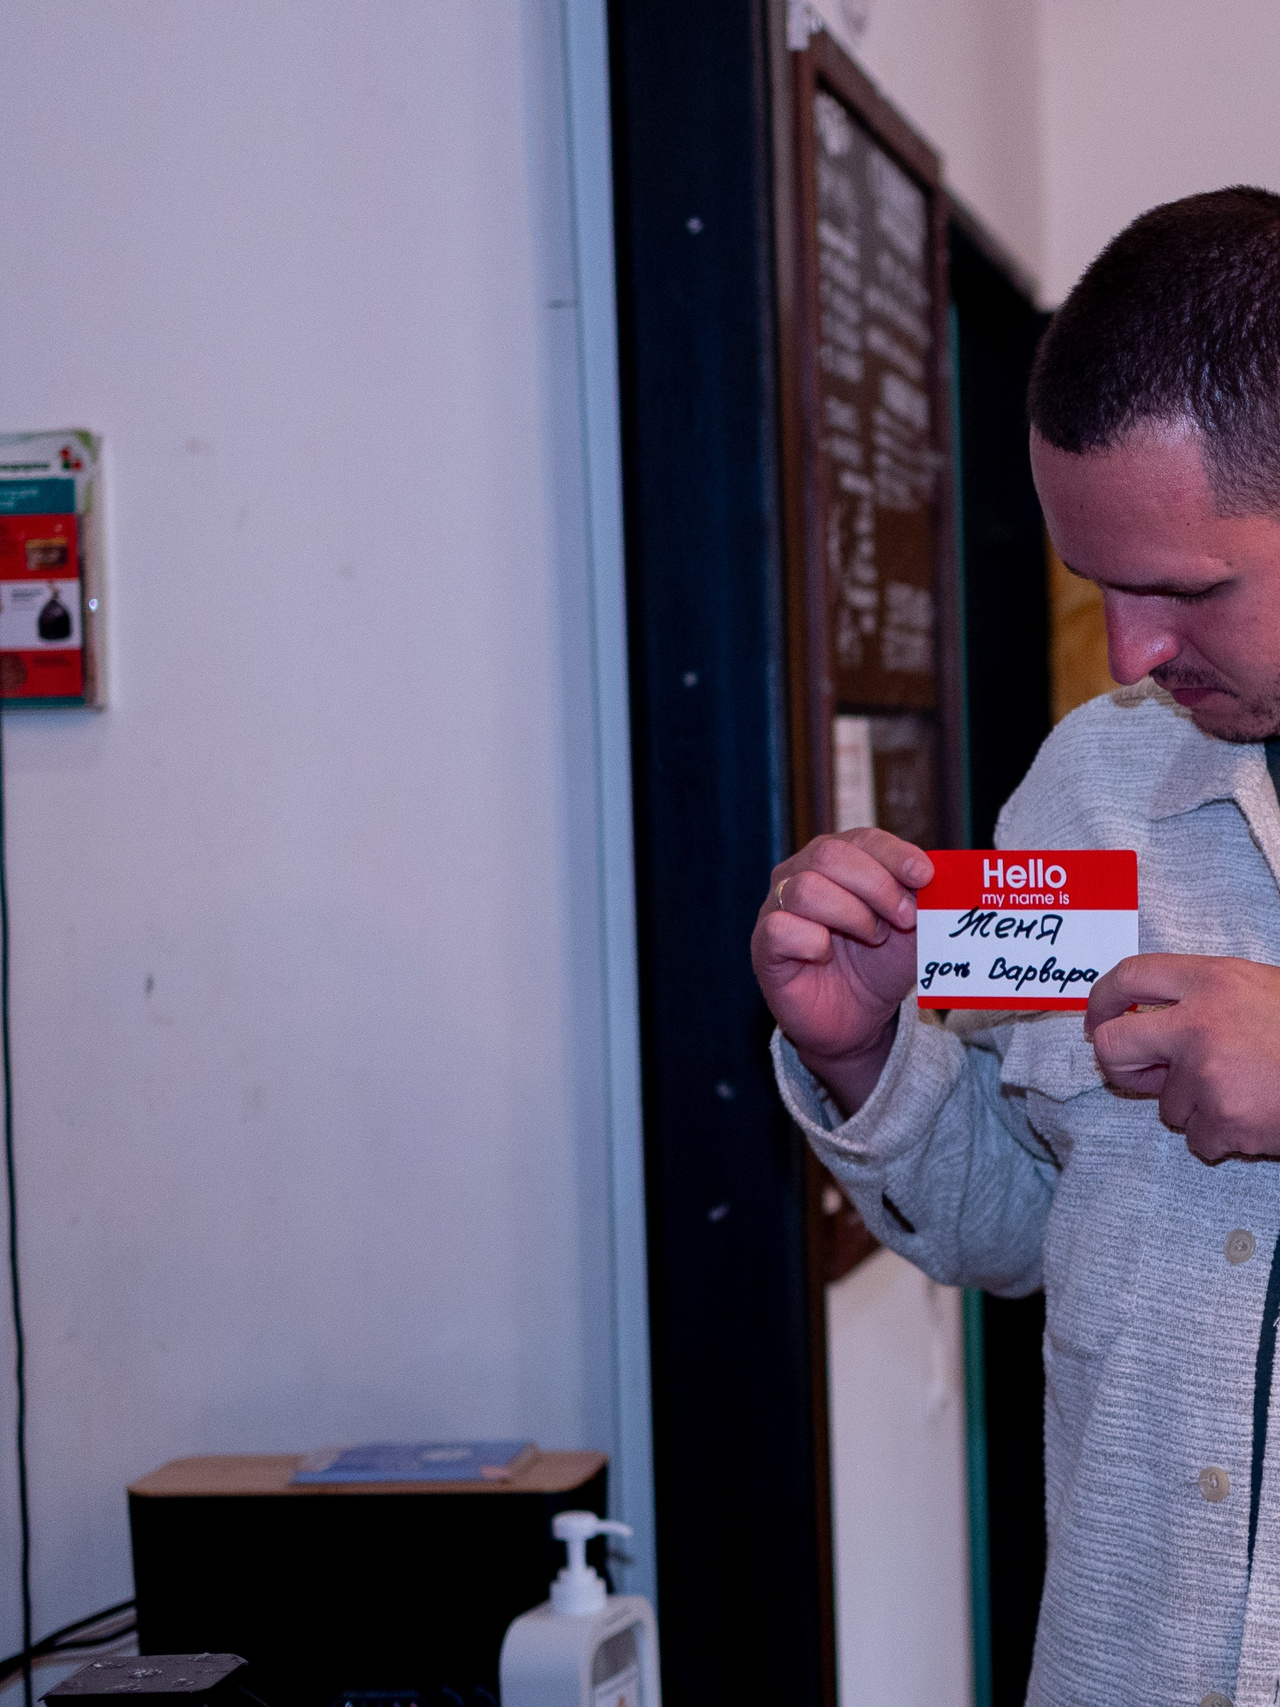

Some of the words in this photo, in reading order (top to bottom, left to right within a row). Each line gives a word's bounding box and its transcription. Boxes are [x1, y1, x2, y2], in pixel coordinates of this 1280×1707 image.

[983, 859, 1067, 889] Hello
[982, 893, 1005, 907] my
[1010, 893, 1054, 905] name
[1059, 891, 1070, 905] is
[988, 957, 1099, 993] Варвара
